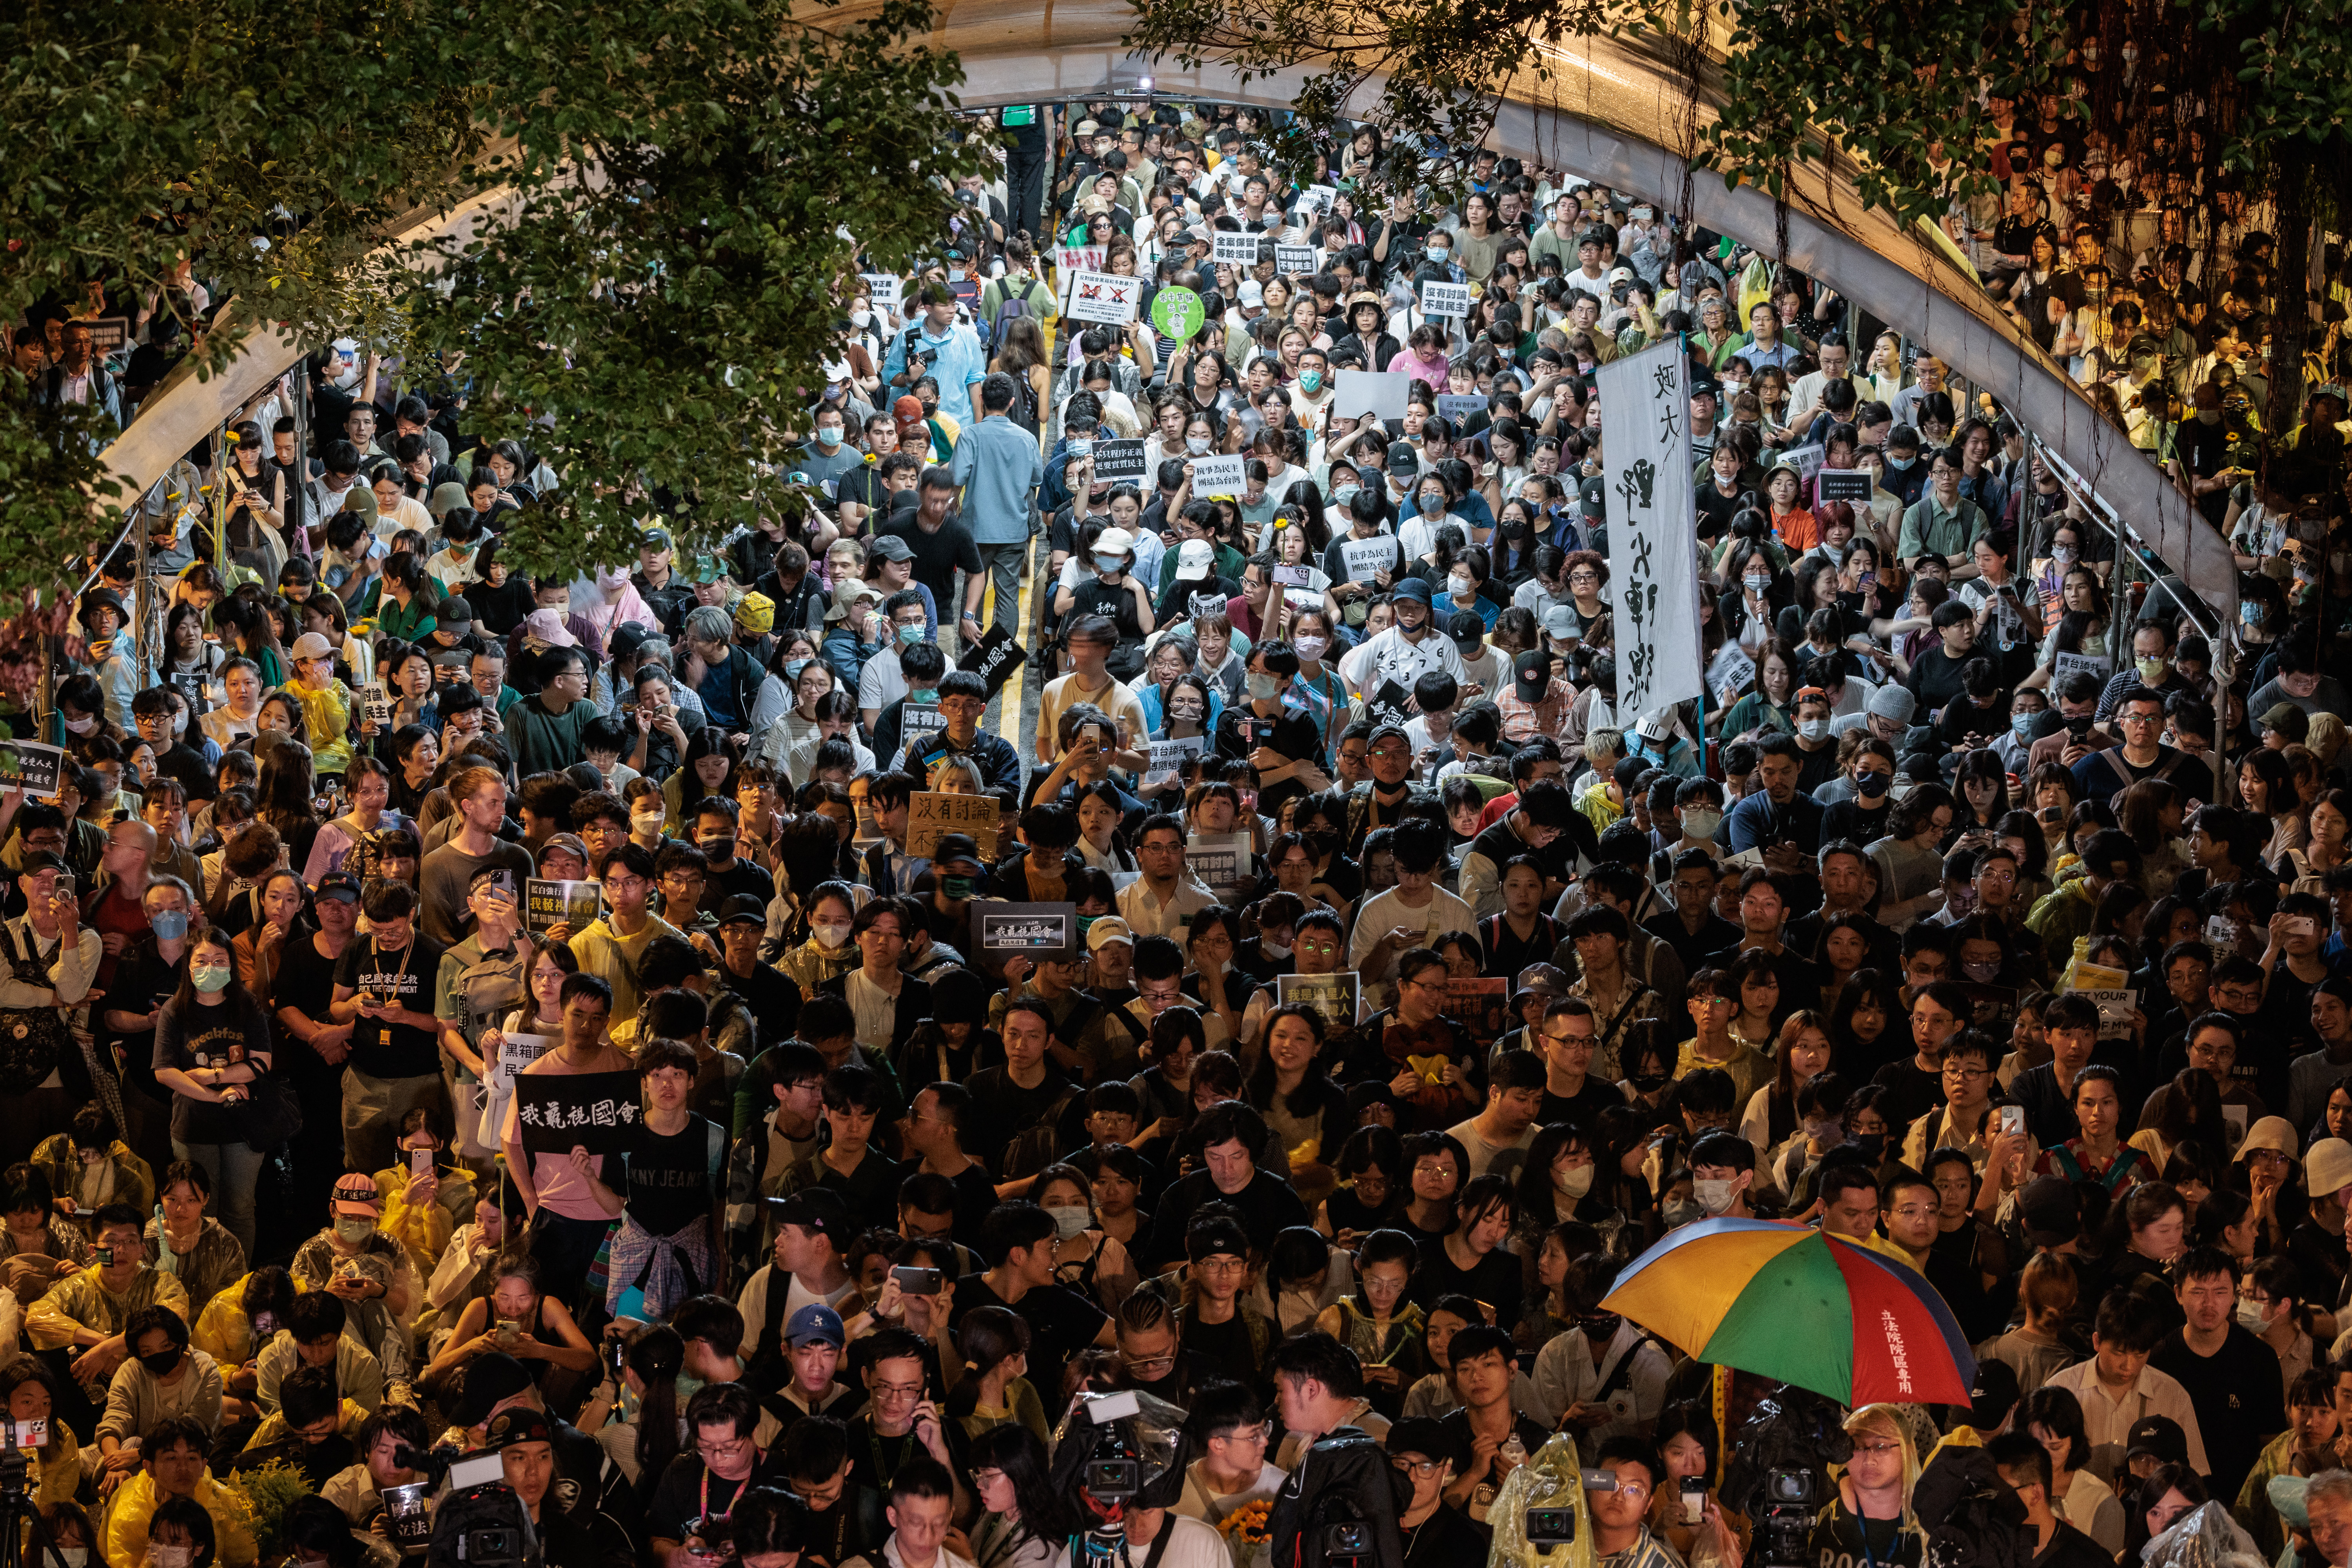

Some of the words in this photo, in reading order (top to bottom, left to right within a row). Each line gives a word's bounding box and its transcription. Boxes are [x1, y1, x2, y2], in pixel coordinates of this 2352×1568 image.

[1216, 237, 1255, 247] 全案保留
[1216, 248, 1255, 259] 等於沒審
[1278, 251, 1312, 260] 沒有討論
[1279, 261, 1312, 270] 不是民主
[1079, 274, 1134, 287] 反對國會黑箱和多數暴力
[1160, 292, 1194, 303] 求卡其褲
[1426, 287, 1467, 300] 沒有討論
[1168, 304, 1188, 313] 品牌
[1425, 299, 1466, 312] 不是民主
[1094, 448, 1143, 459] 不只程序正義
[1096, 459, 1144, 470] 更要實質民主
[1196, 464, 1239, 475] 抗爭為民主
[1198, 475, 1241, 486] 團結為台灣
[1591, 490, 1599, 503] LA
[1350, 548, 1392, 561] 抗爭為民主
[1351, 559, 1393, 572] 團結為台灣
[1377, 651, 1385, 660] 4
[1389, 660, 1396, 670] 5
[1419, 659, 1426, 668] 7
[1404, 672, 1410, 682] 3
[365, 704, 387, 720] 民主
[905, 710, 948, 727] 沒有討
[1149, 744, 1187, 757] 賣台舔共
[17, 756, 53, 769] 院變人大
[916, 797, 993, 822] 沒有討論
[530, 897, 595, 914] 我藐視國會
[995, 925, 1054, 938] 我藐視國會
[359, 973, 418, 985] 自己國家自己救
[359, 984, 370, 993] FUCK
[372, 984, 383, 993] THE
[2090, 991, 2128, 1002] YOUR
[186, 1027, 245, 1053] Breakfast
[505, 1043, 553, 1059] 黑箱國
[520, 1098, 639, 1129] 我藐視國會
[627, 1169, 656, 1187] KNY
[659, 1169, 703, 1189] JEANS
[1881, 1309, 1912, 1394] 立法院院區專用
[837, 1514, 846, 1543] DIGITAL
